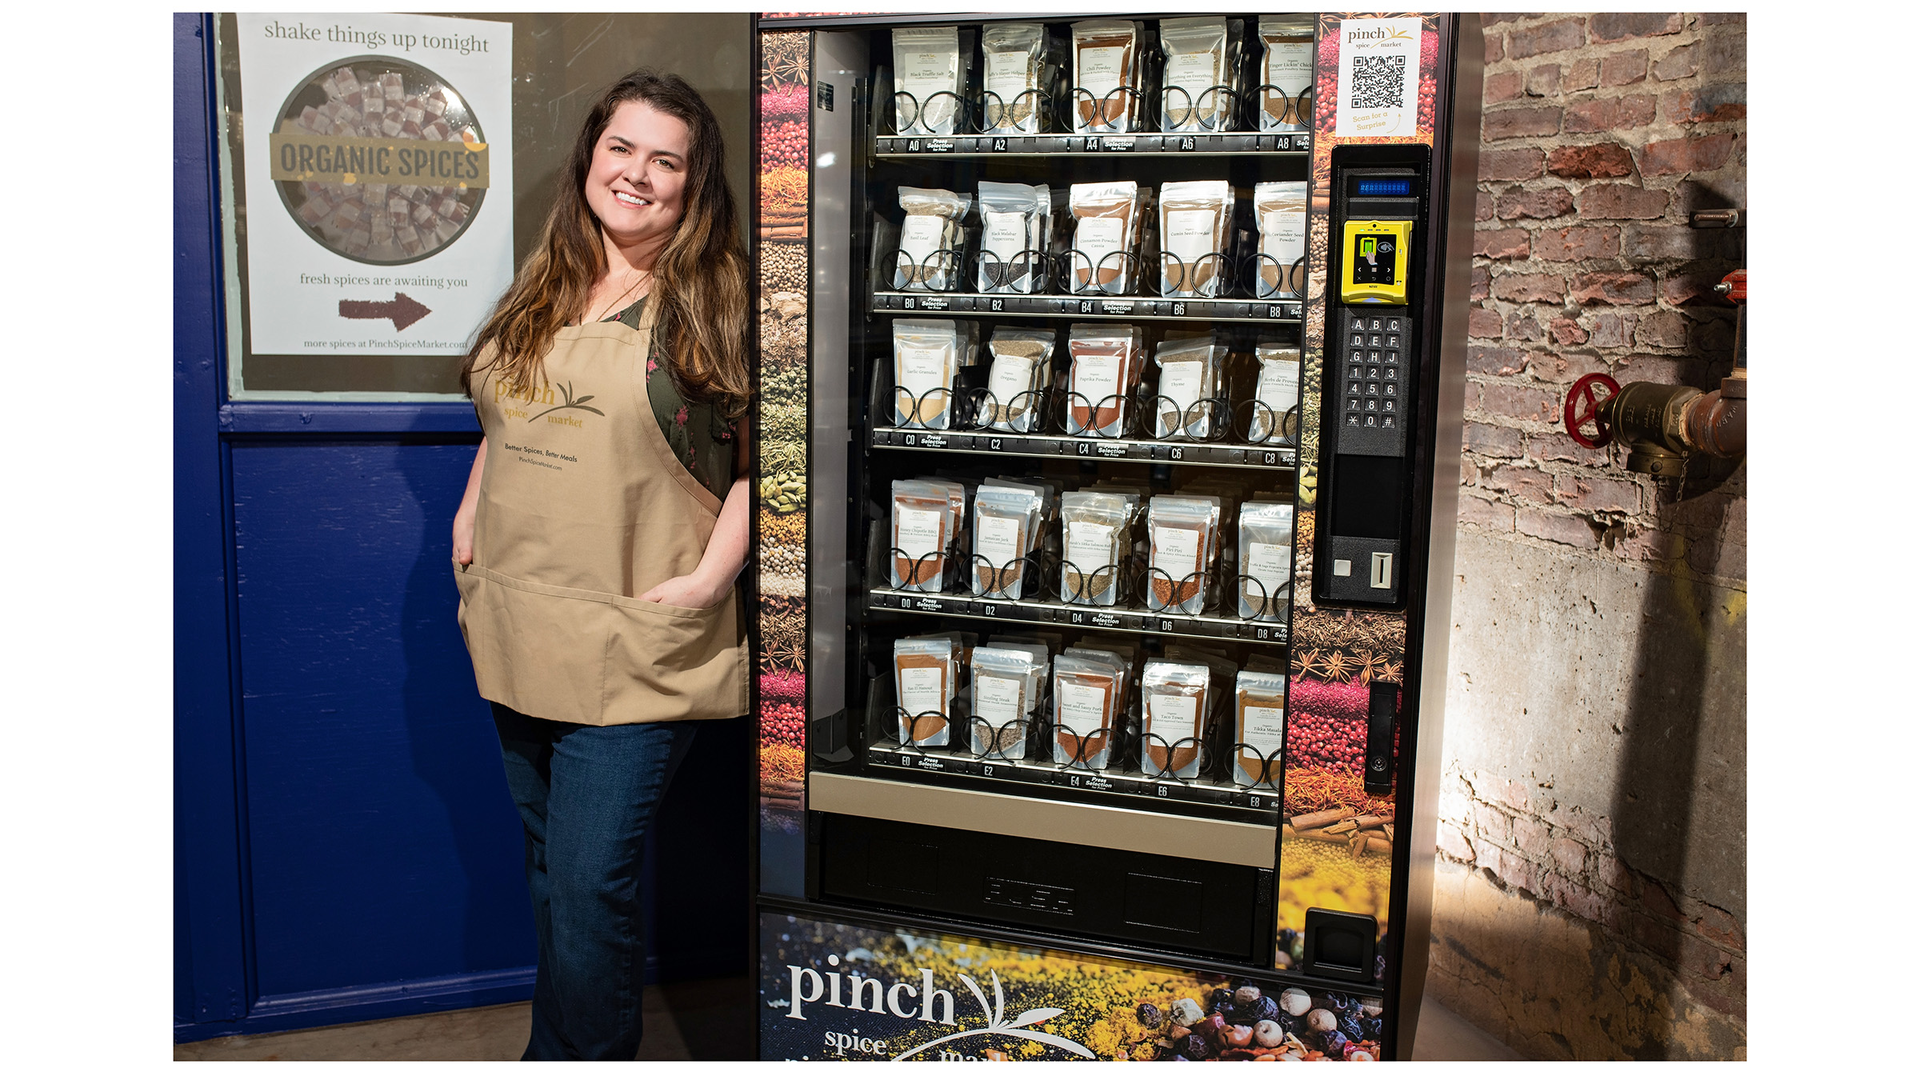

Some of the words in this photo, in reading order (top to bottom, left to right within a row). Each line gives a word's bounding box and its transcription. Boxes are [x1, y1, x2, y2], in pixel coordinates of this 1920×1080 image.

[265, 22, 321, 41] shake
[328, 26, 386, 49] things
[392, 33, 417, 51] up
[423, 34, 489, 55] tonight
[1348, 27, 1385, 43] pinch
[1356, 42, 1370, 50] spice
[1372, 112, 1380, 120] for
[1356, 121, 1386, 131] Surprise
[909, 141, 919, 151] A0
[995, 140, 1005, 150] A2
[1087, 140, 1098, 150] A4
[1182, 139, 1193, 150] A6
[1277, 138, 1289, 149] A8
[281, 143, 390, 176] ORGANIC
[398, 148, 479, 179] SPICES
[300, 274, 331, 285] fresh
[334, 275, 370, 287] spices
[373, 277, 392, 286] are
[394, 275, 444, 289] awaiting
[447, 278, 468, 289] you
[905, 299, 914, 309] B0
[992, 300, 1003, 310] B2
[1082, 302, 1092, 313] B4
[1174, 304, 1185, 315] B6
[1270, 307, 1280, 318] B8
[1355, 320, 1362, 329] A
[1374, 321, 1380, 329] B
[1392, 321, 1398, 330] C
[329, 340, 355, 349] spices
[358, 340, 366, 348] at
[1355, 336, 1361, 345] D
[1373, 337, 1378, 346] E
[1391, 337, 1396, 346] F
[1354, 352, 1360, 361] G
[1372, 353, 1378, 362] H
[1389, 353, 1395, 362] J
[1354, 368, 1357, 377] 1
[1371, 369, 1377, 377] 2
[1389, 369, 1394, 378] 3
[1352, 384, 1357, 393] 4
[1370, 385, 1375, 393] 5
[1387, 385, 1393, 394] 6
[1352, 400, 1357, 408] 7
[1369, 401, 1375, 409] 8
[1387, 402, 1393, 410] 9
[504, 407, 528, 419] spice
[548, 415, 583, 428] market
[1368, 417, 1374, 425] 0
[1385, 417, 1392, 425] #
[906, 435, 915, 445] C0
[992, 439, 1000, 449] C2
[504, 443, 522, 452] Better
[546, 450, 560, 459] Better
[560, 453, 578, 463] Meals
[1079, 444, 1089, 455] C4
[1172, 448, 1182, 459] C6
[1265, 453, 1275, 464] C8
[902, 599, 911, 608] D0
[986, 606, 995, 615] D2
[1073, 613, 1082, 623] D4
[1092, 617, 1120, 625] Selection
[1163, 621, 1172, 631] D6
[1258, 629, 1268, 639] D8
[902, 756, 910, 766] E0
[918, 760, 944, 768] Selection
[985, 766, 993, 776] E2
[1071, 776, 1080, 786] E4
[1085, 780, 1113, 789] Selection
[1091, 776, 1107, 784] Press
[1159, 786, 1168, 797] E6
[1251, 797, 1260, 807] E8
[785, 954, 958, 1027] pinch
[824, 1028, 887, 1056] spice
